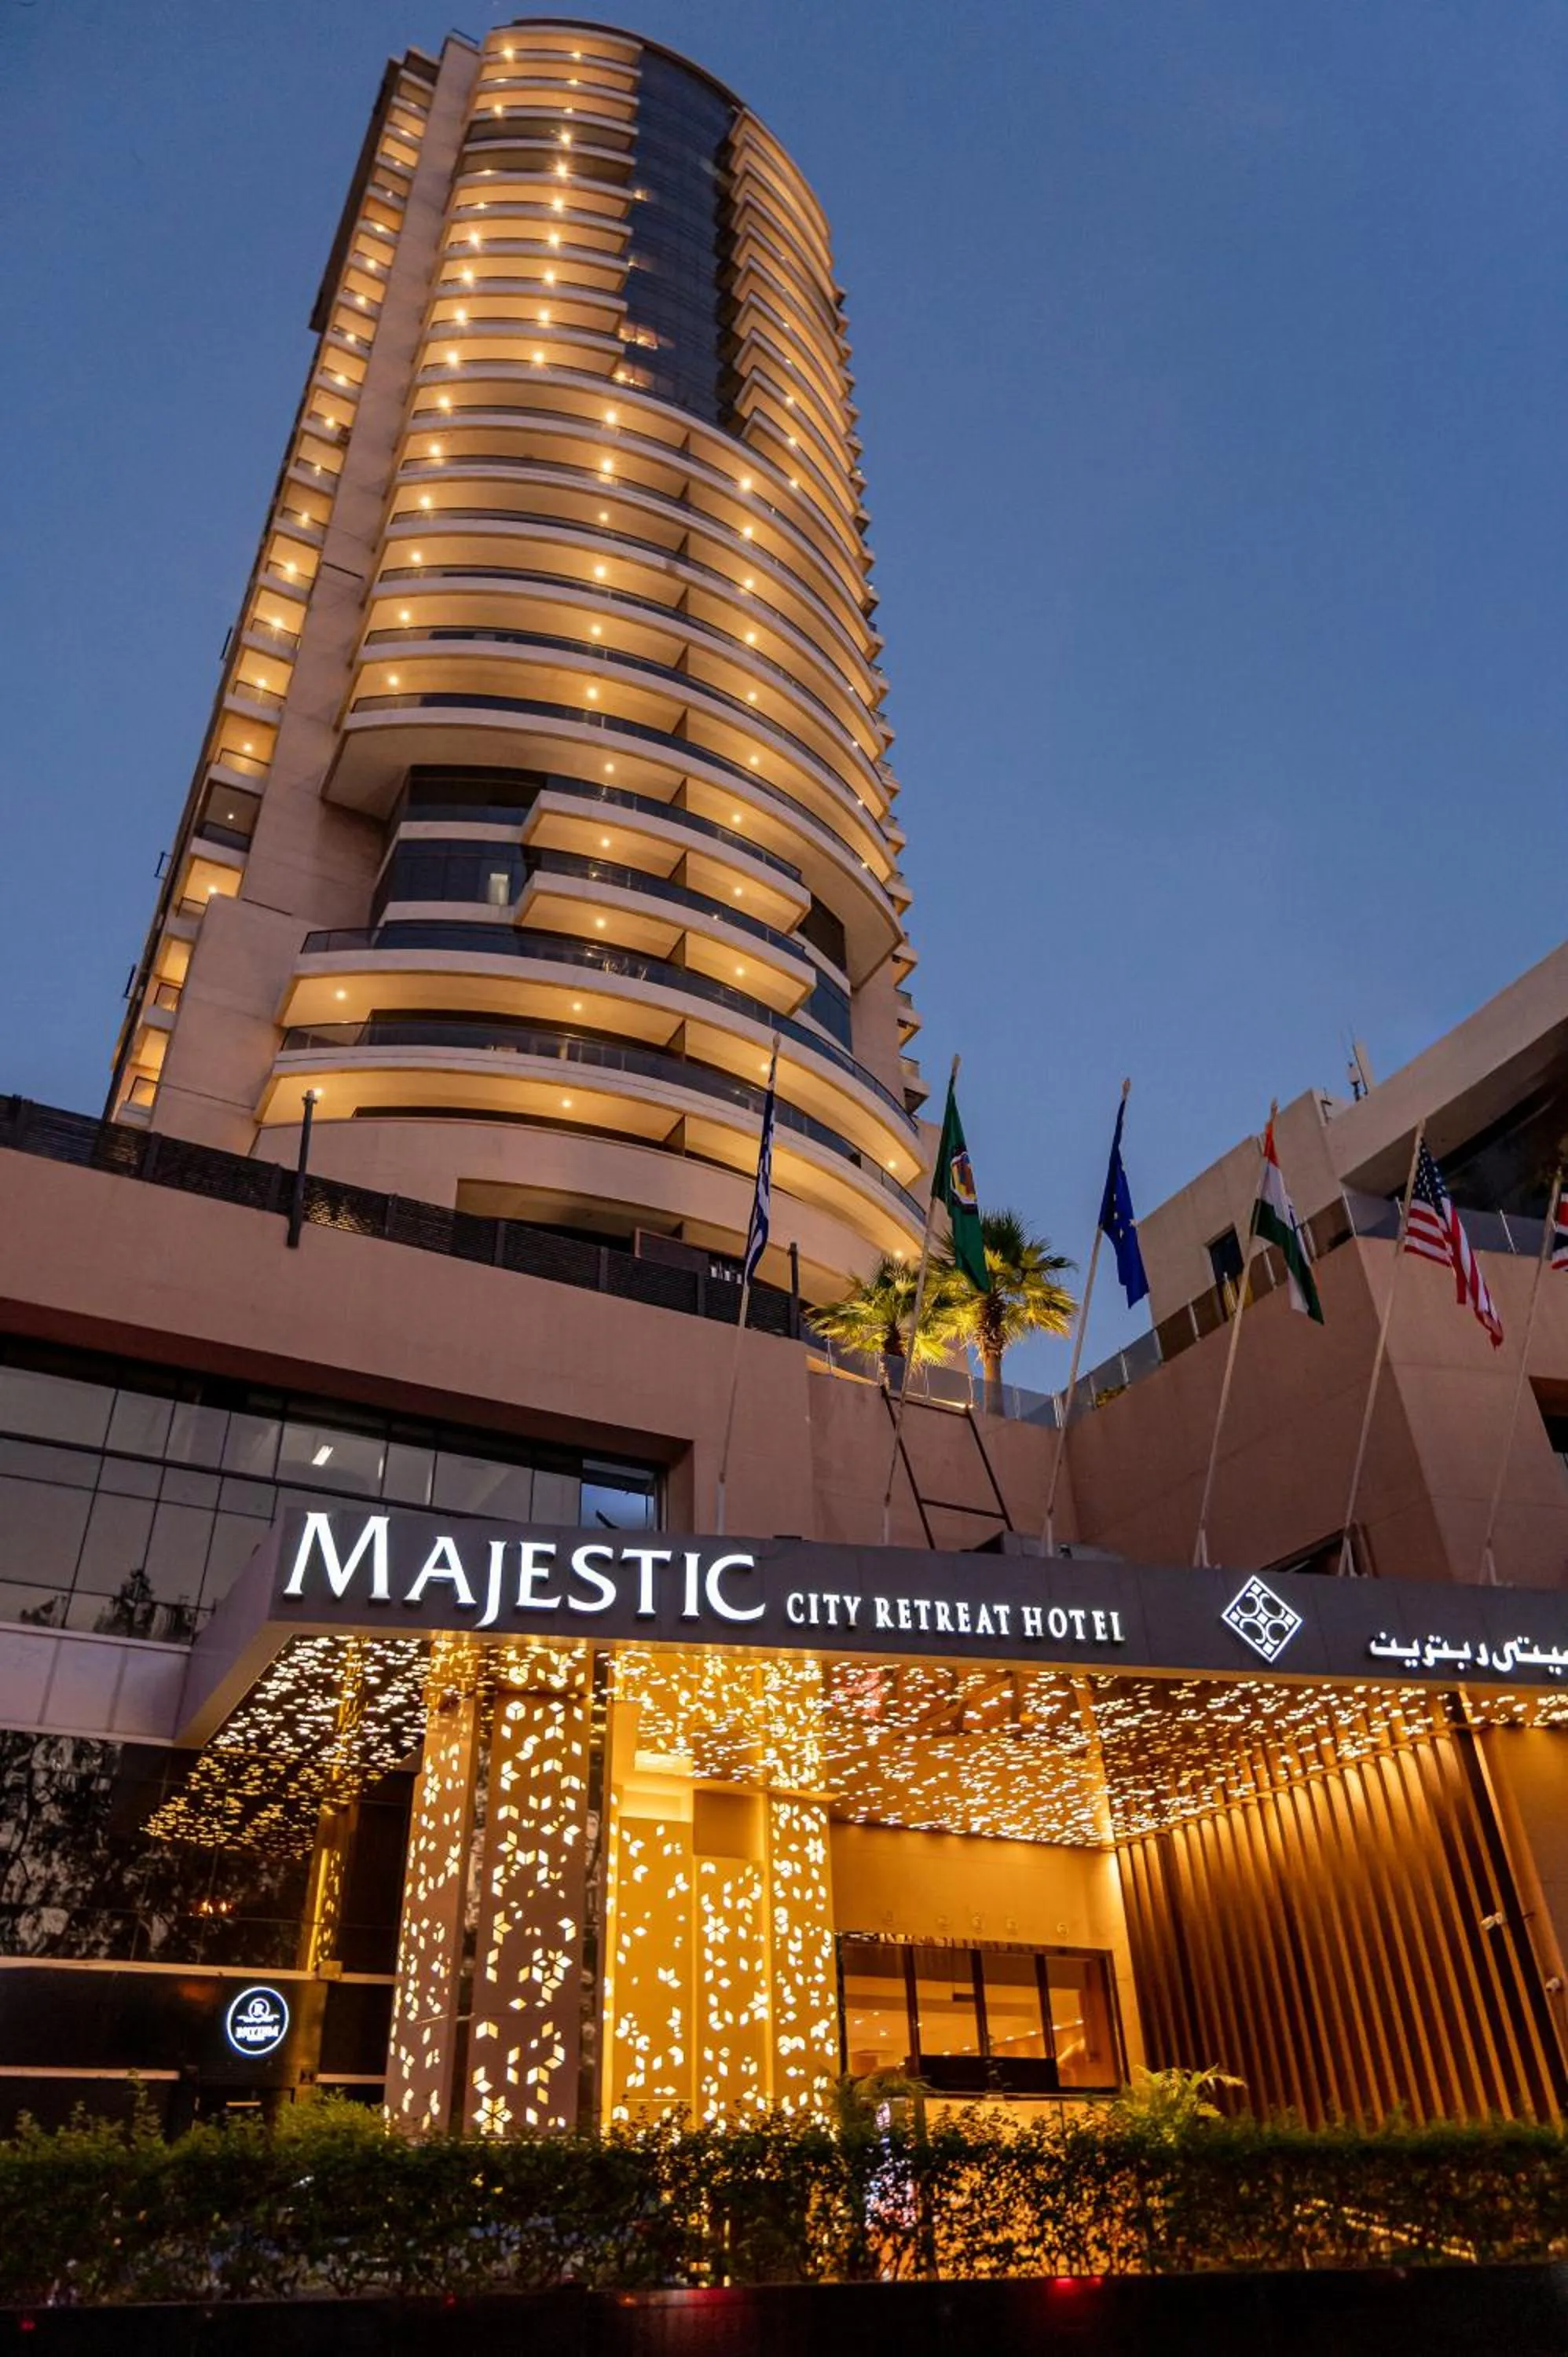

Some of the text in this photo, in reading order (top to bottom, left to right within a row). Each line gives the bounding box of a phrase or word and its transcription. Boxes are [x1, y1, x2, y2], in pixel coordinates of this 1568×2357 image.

[284, 1512, 1125, 1641] MAJESTIC CITY RETREAT HOTEL
